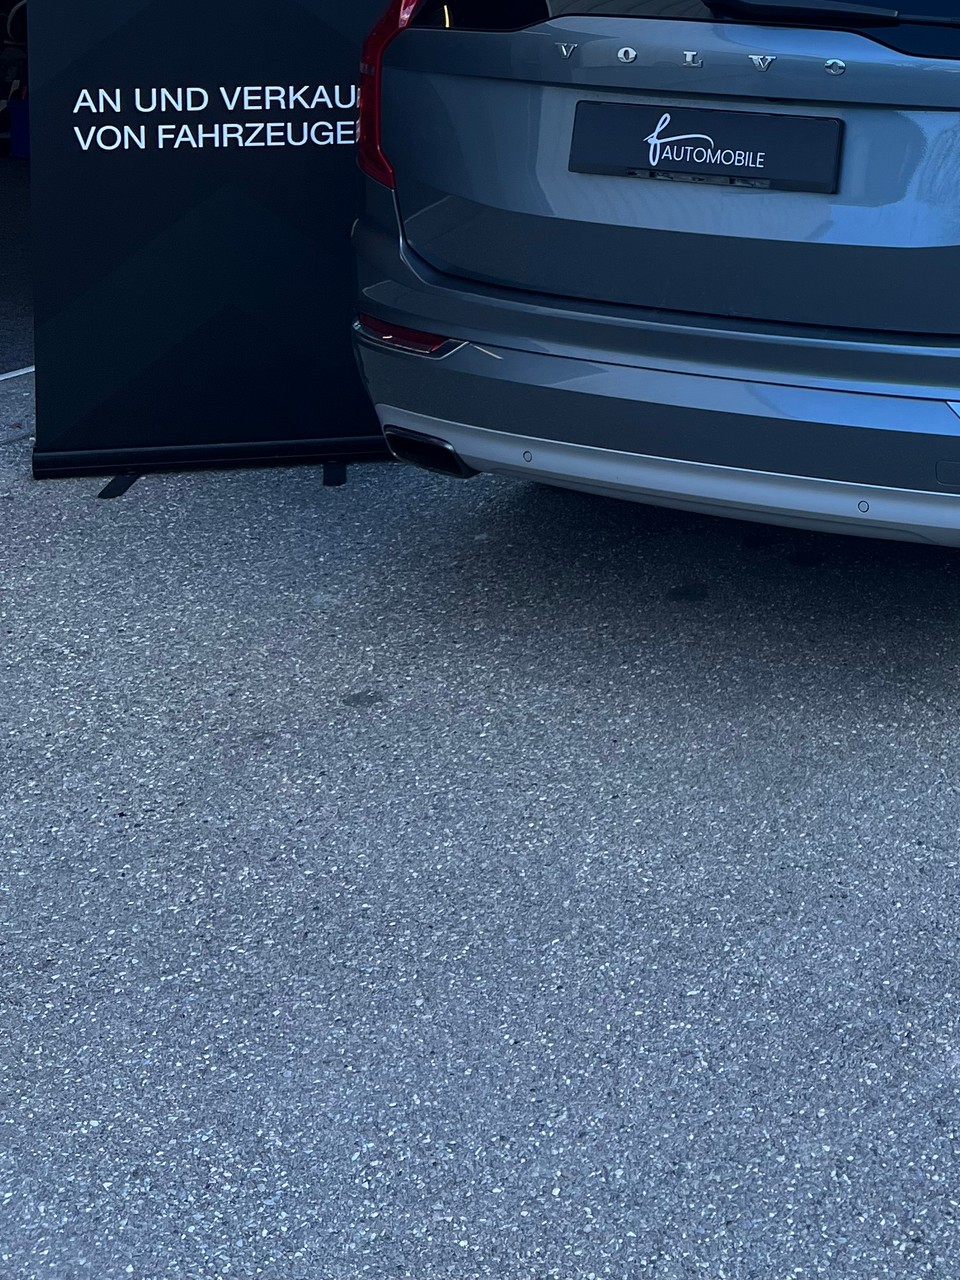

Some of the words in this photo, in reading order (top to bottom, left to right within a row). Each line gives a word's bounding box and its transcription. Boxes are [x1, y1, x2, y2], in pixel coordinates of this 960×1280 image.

[555, 42, 847, 76] VOLVO
[73, 89, 121, 113] AN
[135, 88, 208, 112] UND
[220, 85, 360, 111] VERKAU
[73, 126, 146, 151] VON
[158, 121, 359, 149] FAHRZEUGE
